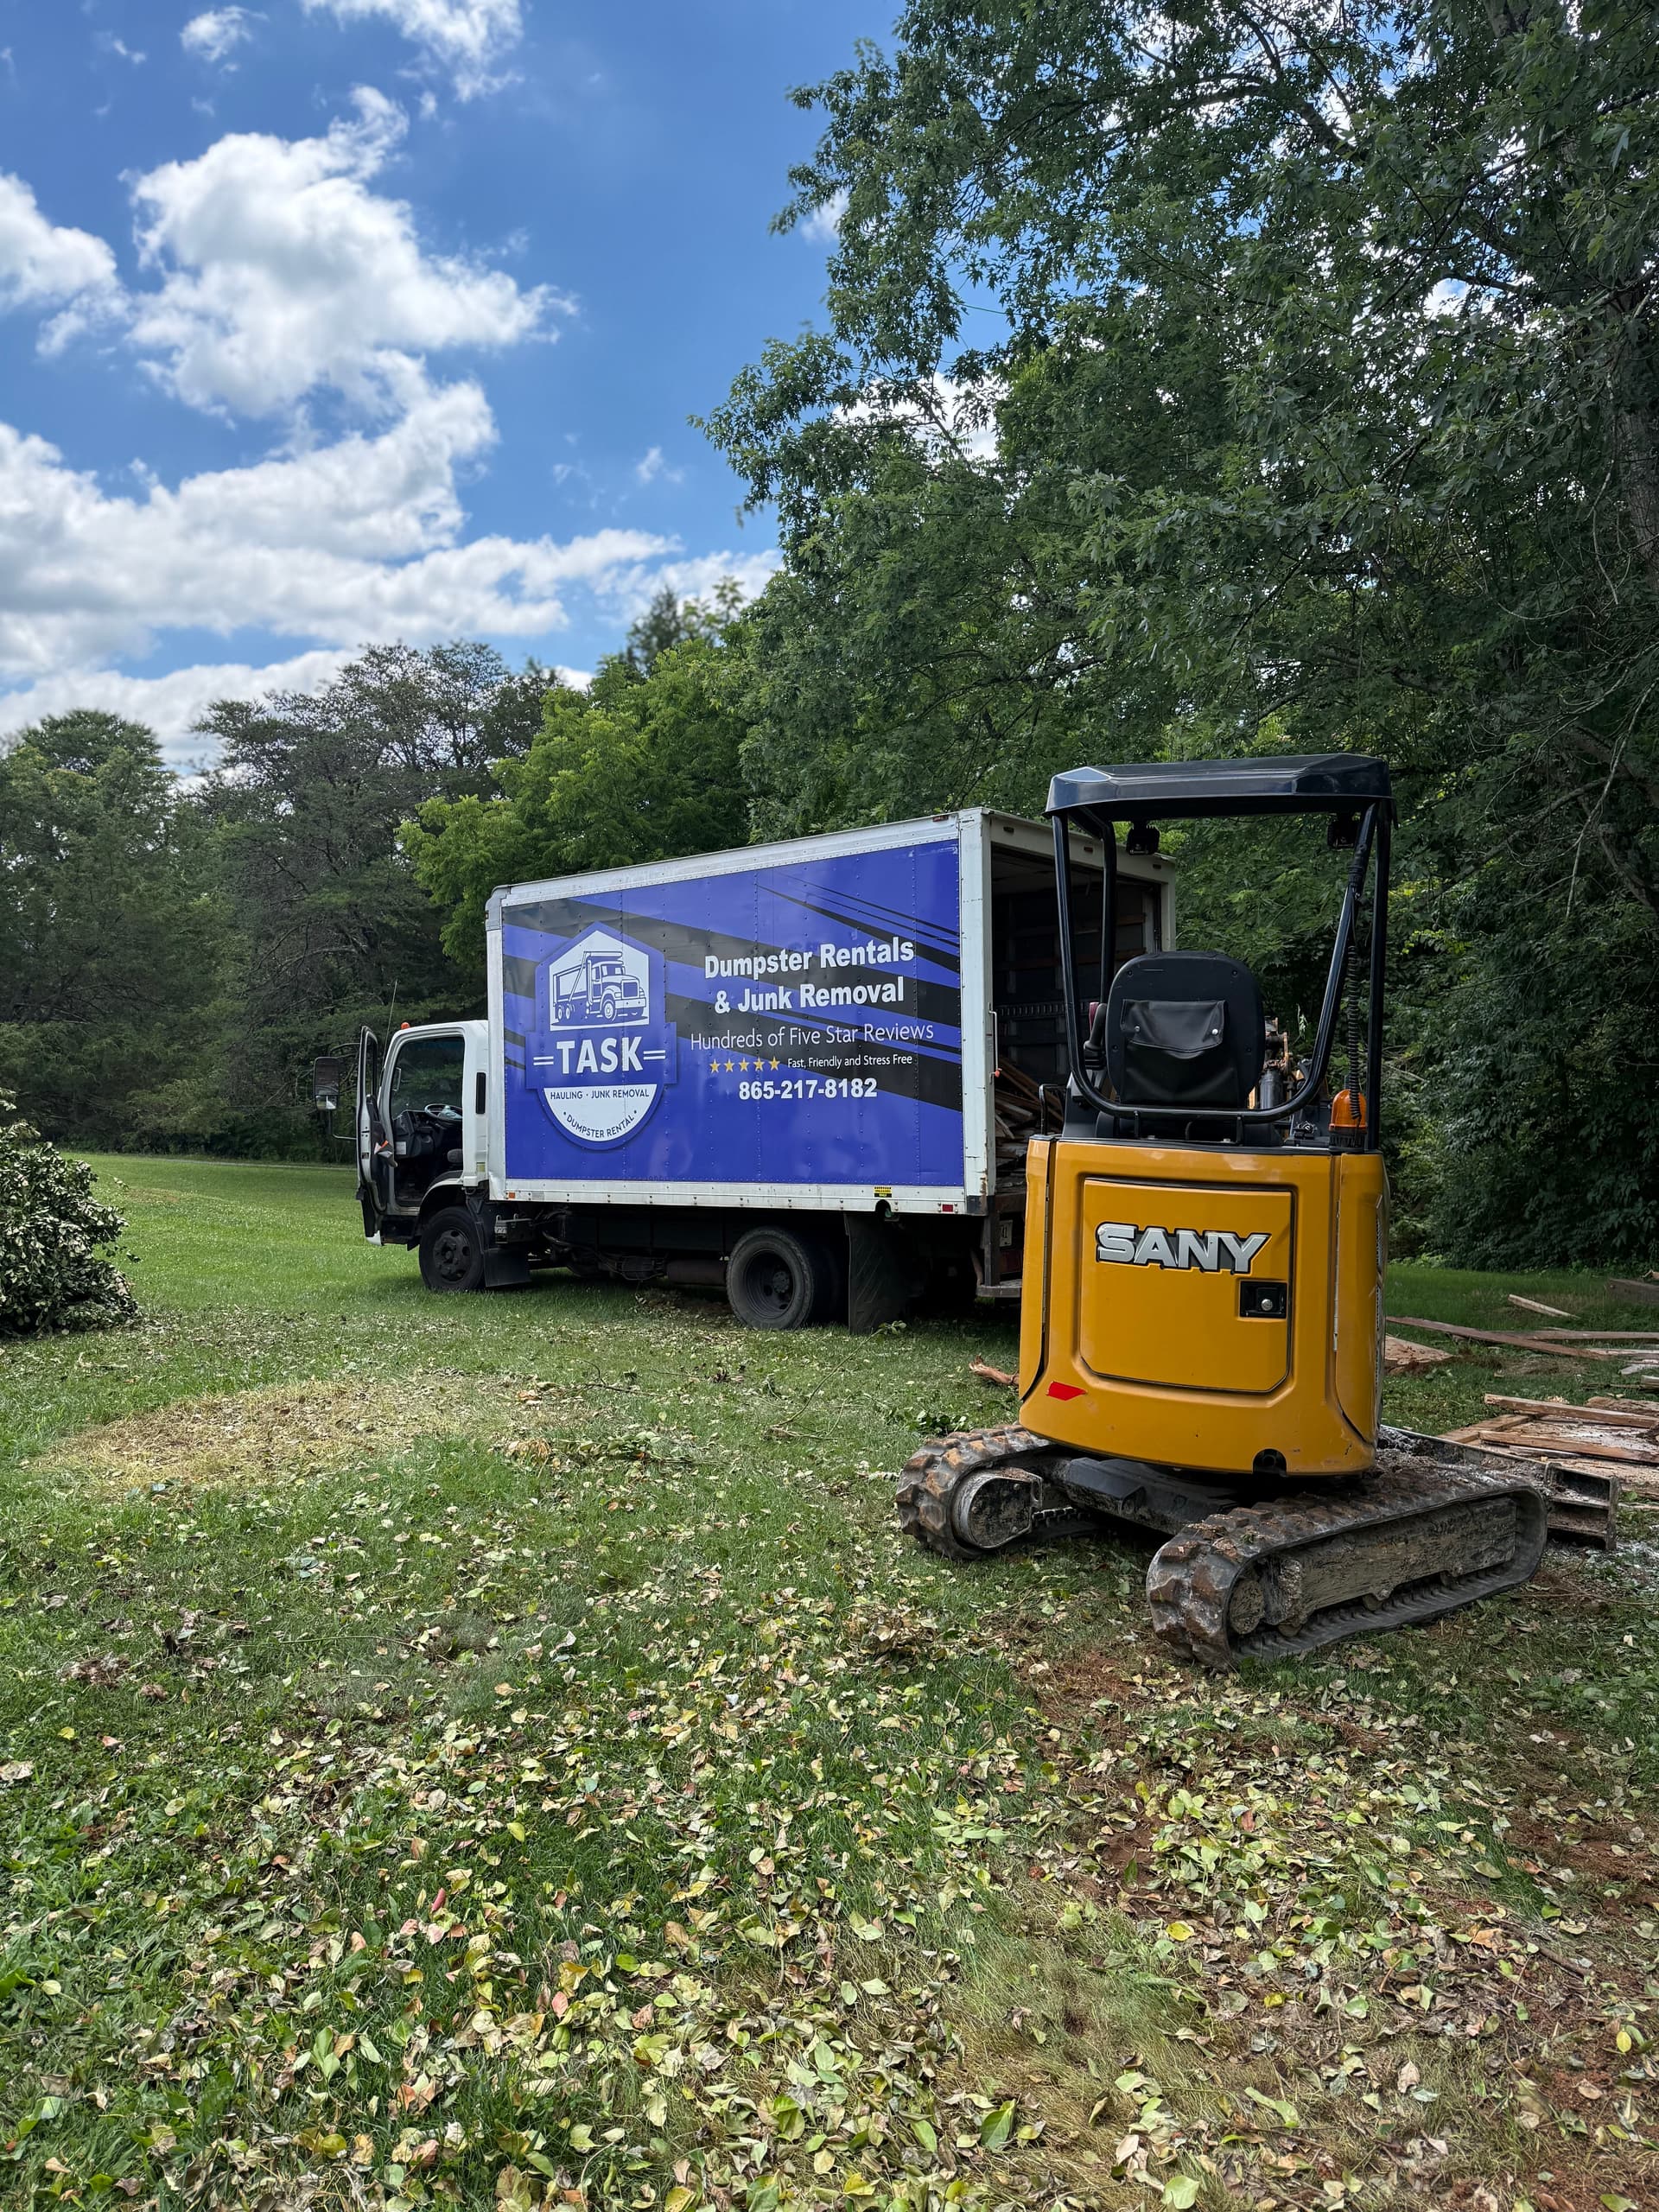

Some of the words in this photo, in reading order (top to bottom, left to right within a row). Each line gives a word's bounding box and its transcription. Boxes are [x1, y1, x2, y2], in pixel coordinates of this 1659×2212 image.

[705, 949, 812, 980] Dumpster
[821, 937, 914, 968] Rentals
[715, 990, 730, 1014] &
[738, 986, 792, 1012] Junk
[800, 976, 904, 1007] Removal
[690, 1029, 762, 1050] Hundreds
[768, 1027, 785, 1046] of
[790, 1027, 820, 1046] Five
[826, 1025, 857, 1043] Star
[864, 1020, 934, 1041] Reviews
[556, 1037, 643, 1074] TASK
[787, 1058, 806, 1069] Fast,
[808, 1057, 842, 1069] Friendly
[844, 1057, 861, 1066] and
[863, 1055, 890, 1065] Stress
[893, 1055, 912, 1065] Free
[550, 1090, 582, 1100] HAULING
[590, 1090, 610, 1099] JUNK
[613, 1087, 649, 1098] REMOVAL
[739, 1078, 878, 1100] 865-217-8182
[567, 1115, 605, 1138] DUMPSTER
[607, 1115, 634, 1137] RENTAL
[1097, 1223, 1270, 1273] SANY
